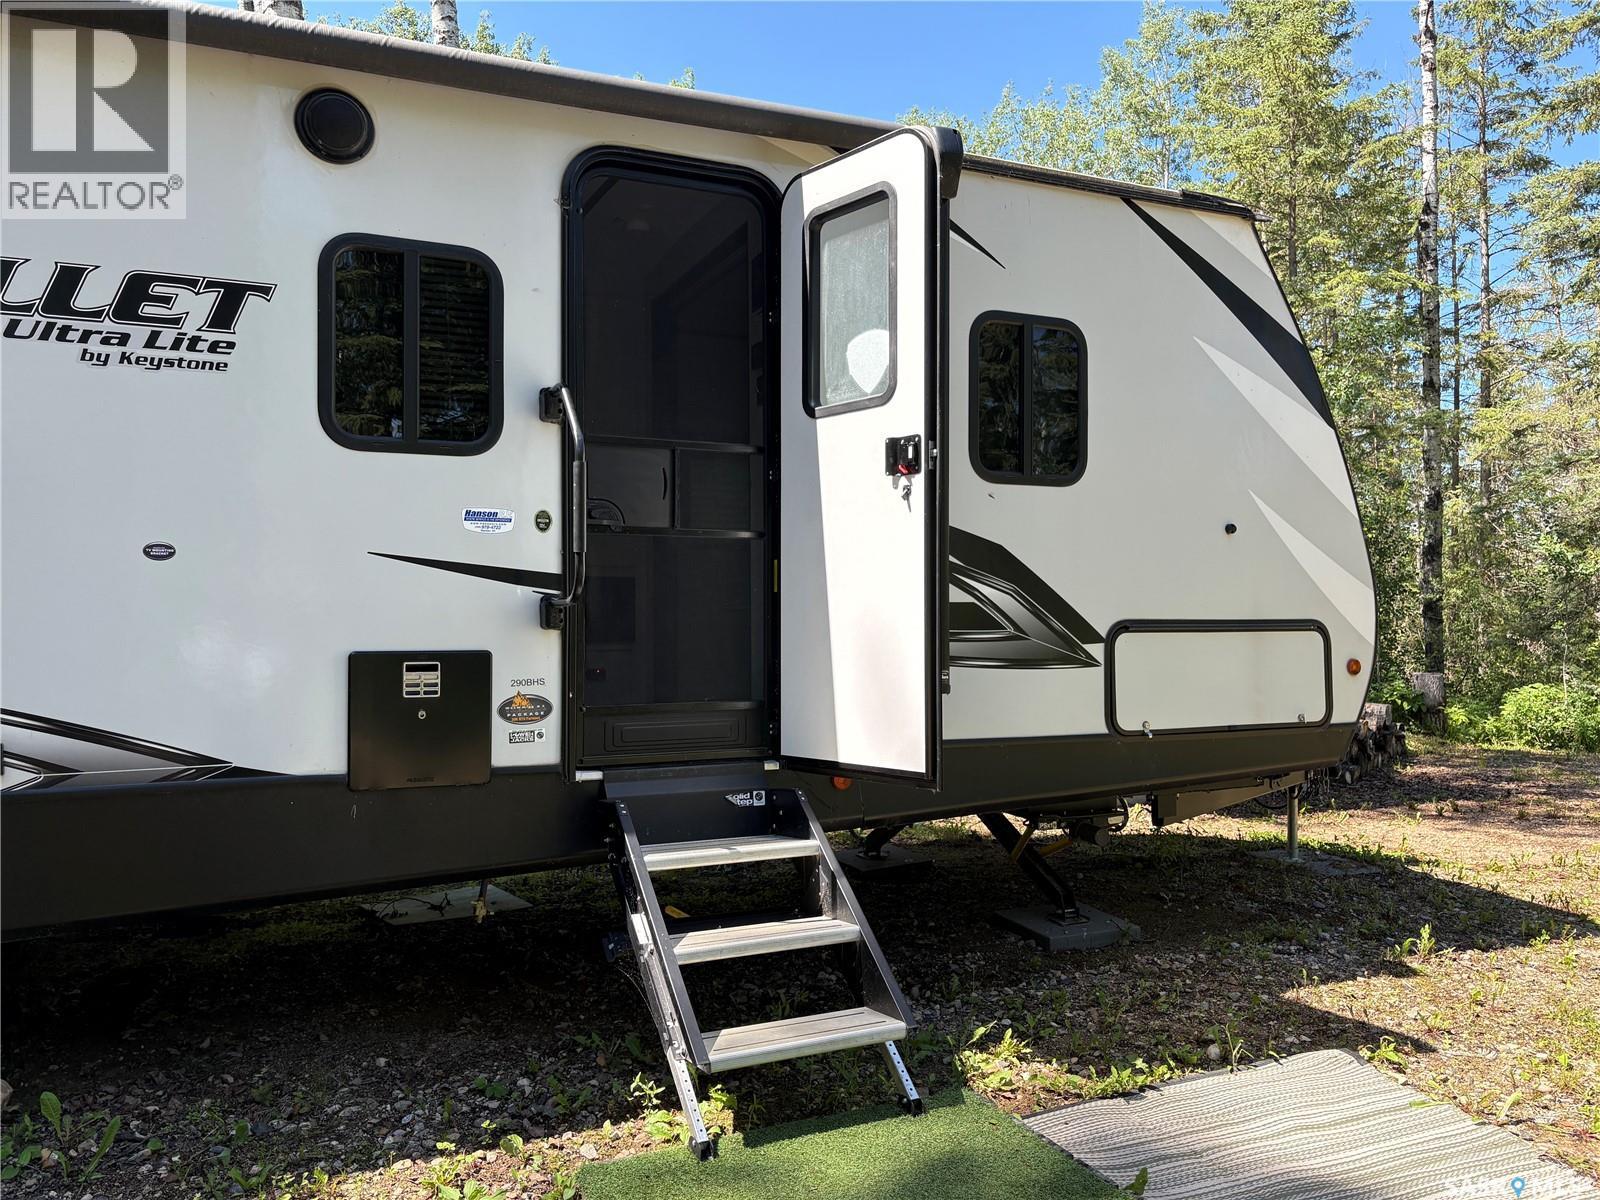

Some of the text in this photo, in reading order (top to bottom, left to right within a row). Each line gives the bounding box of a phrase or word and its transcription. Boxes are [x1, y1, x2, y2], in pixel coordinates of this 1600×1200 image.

[2, 318, 237, 355] Ultra Lite
[80, 348, 229, 372] by Keystone
[464, 509, 498, 517] Hanson
[510, 678, 545, 687] 290BHS
